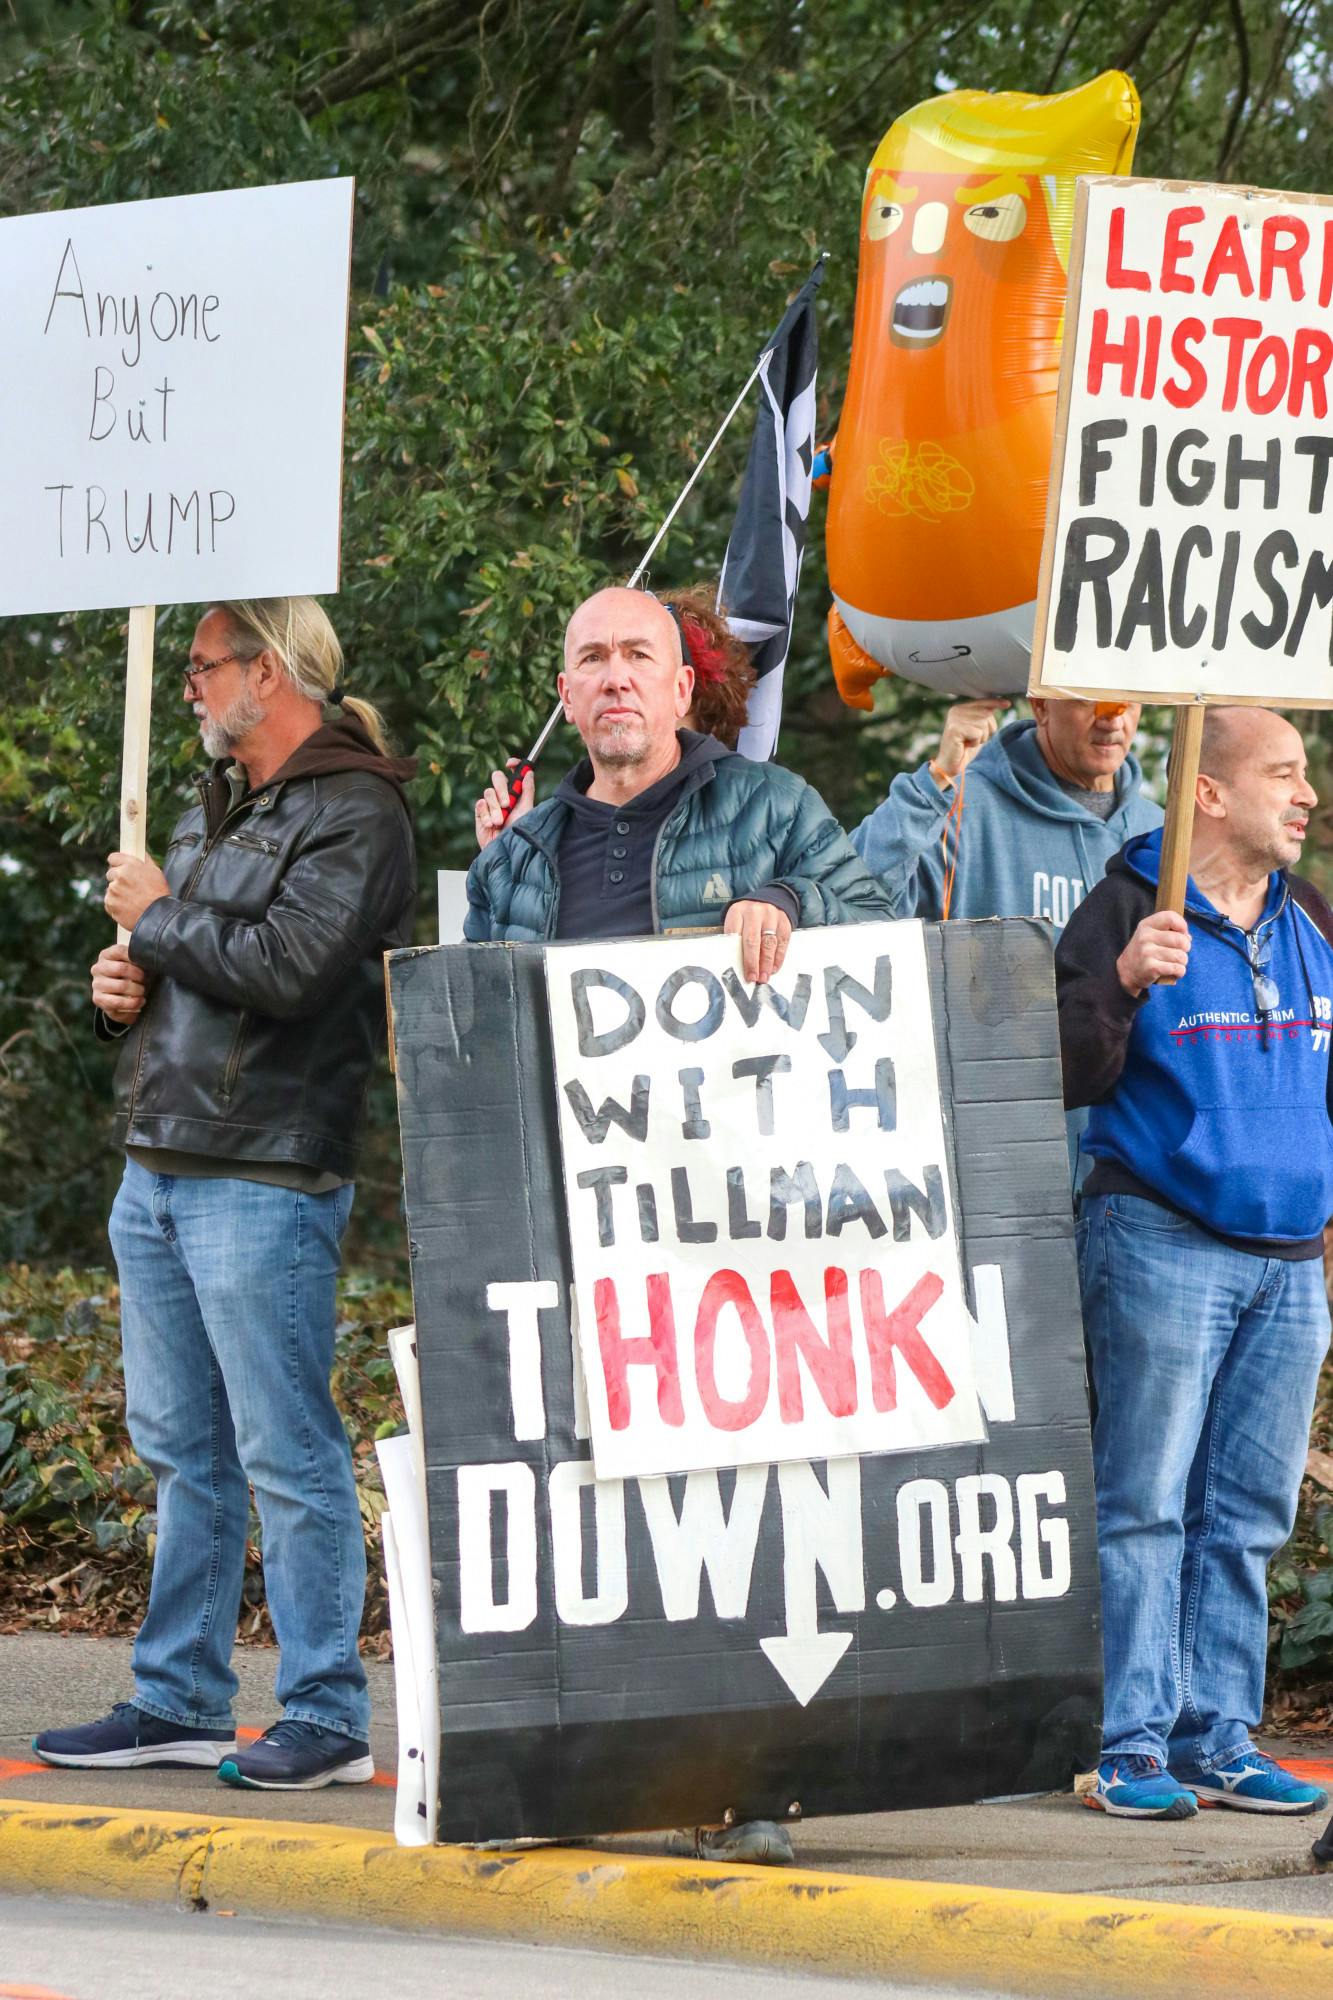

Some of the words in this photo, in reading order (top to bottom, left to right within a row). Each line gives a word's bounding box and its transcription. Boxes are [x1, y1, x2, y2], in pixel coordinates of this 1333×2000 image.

[44, 238, 221, 367] Anyone
[89, 366, 176, 444] But
[1078, 418, 1333, 514] FIGHT
[44, 485, 236, 558] TRUMP
[570, 955, 893, 1062] DOWN
[1178, 1010, 1250, 1028] AUTHENTIC
[1254, 1008, 1295, 1024] DENIM
[563, 1056, 898, 1145] WITH
[576, 1161, 948, 1248] TILLMAN
[593, 1265, 957, 1432] HONK
[457, 1456, 1071, 1634] DOWN.ORG
